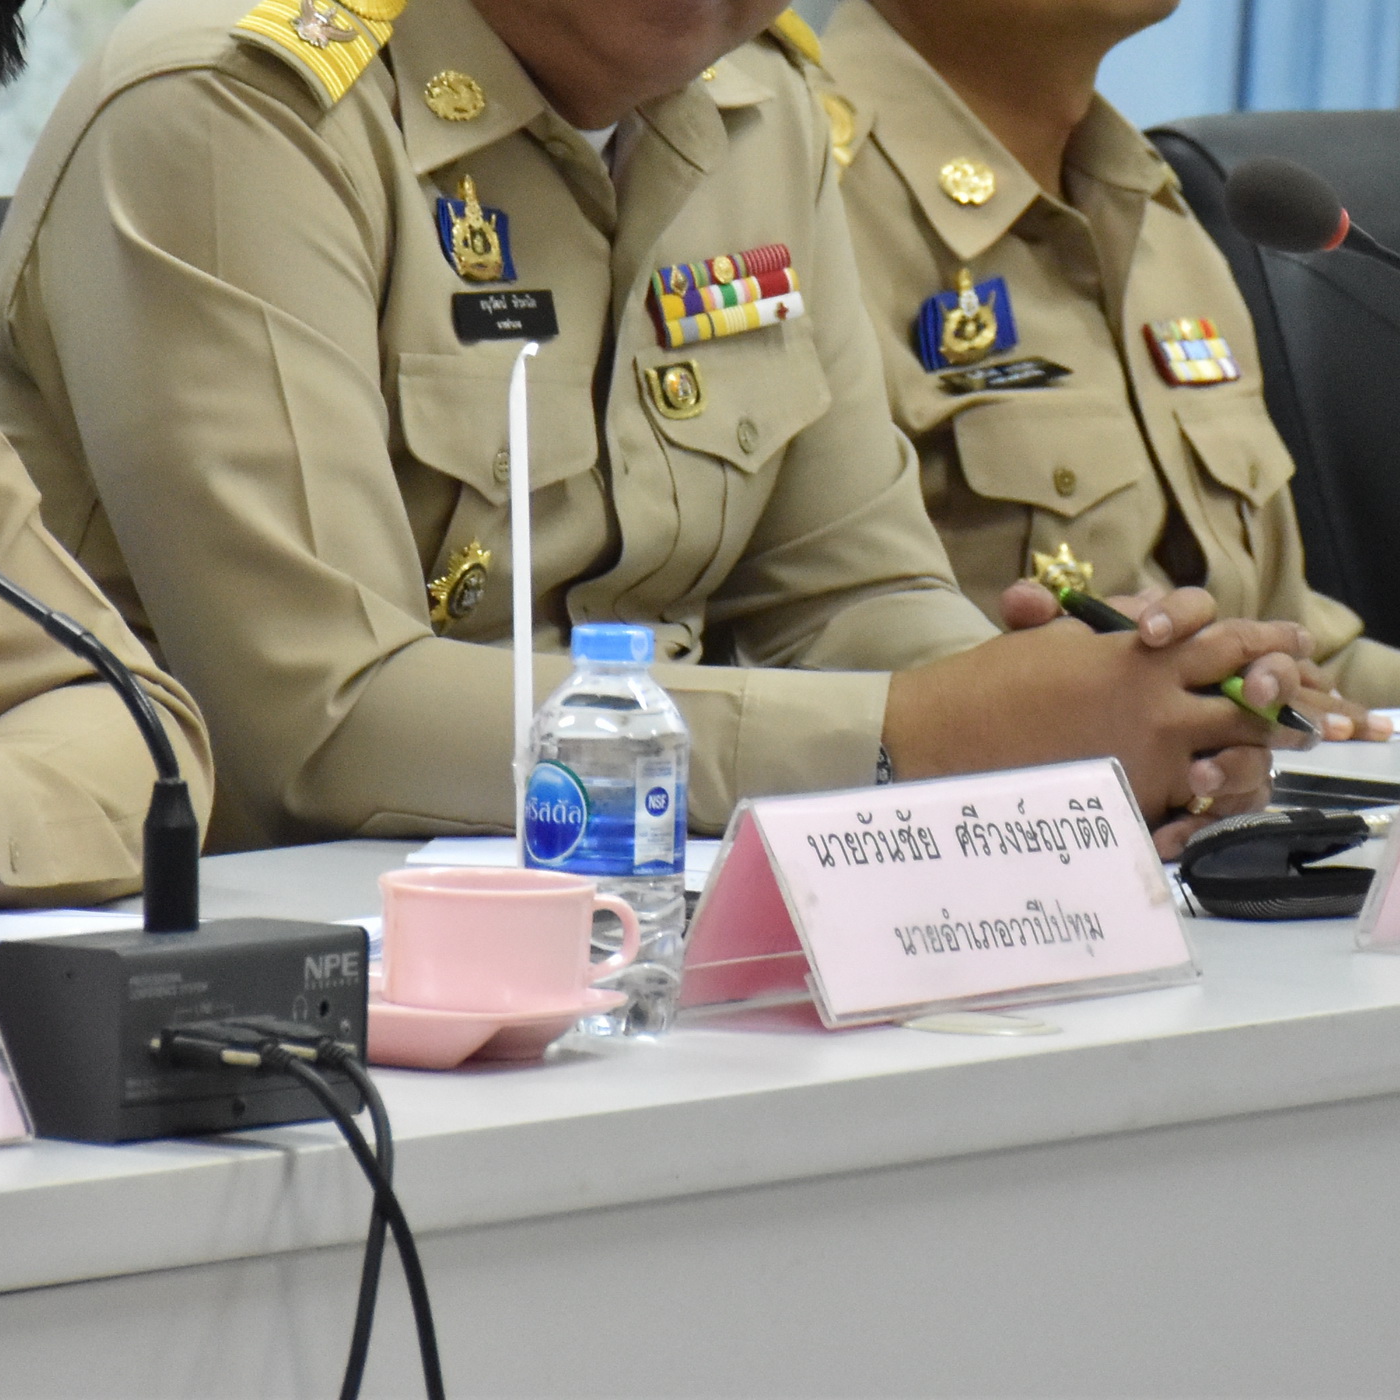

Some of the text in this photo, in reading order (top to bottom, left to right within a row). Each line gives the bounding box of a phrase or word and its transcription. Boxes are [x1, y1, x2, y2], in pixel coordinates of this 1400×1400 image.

[807, 797, 1118, 868] นายวันชัย ศรีวงษ์ญาติดี
[894, 899, 1104, 957] นายอำเภอวาปีปทุม
[305, 952, 359, 979] NPE
